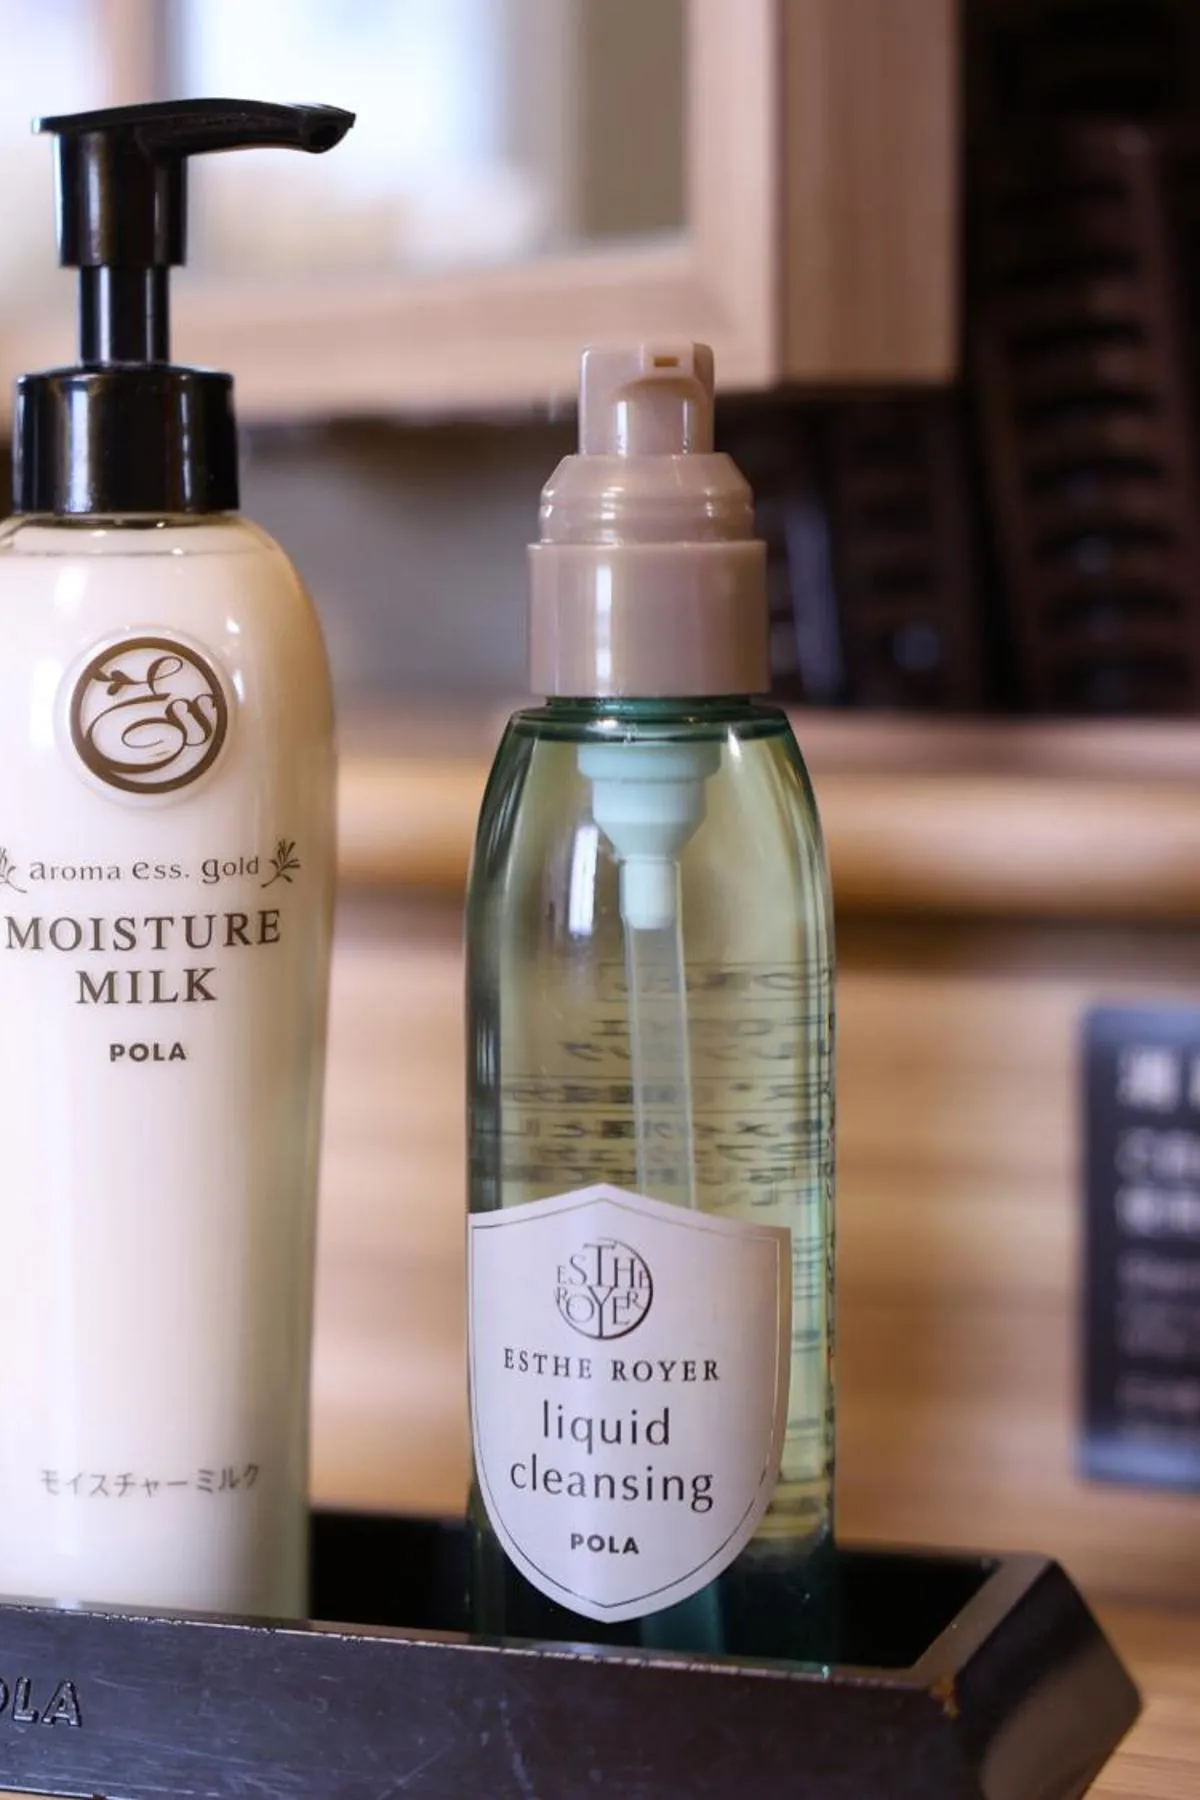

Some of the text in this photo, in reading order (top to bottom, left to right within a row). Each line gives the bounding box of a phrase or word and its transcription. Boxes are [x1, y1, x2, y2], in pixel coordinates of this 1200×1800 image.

[30, 856, 259, 884] aroma ess. gold
[4, 909, 282, 952] MOISTURE
[76, 966, 218, 1005] MILK
[109, 1042, 188, 1063] POLA
[504, 1348, 720, 1382] ESTHE ROYER
[543, 1399, 670, 1454] liquid
[40, 1462, 260, 1498] モイスチャーミルク
[509, 1453, 715, 1513] cleansing
[570, 1533, 640, 1555] POLA
